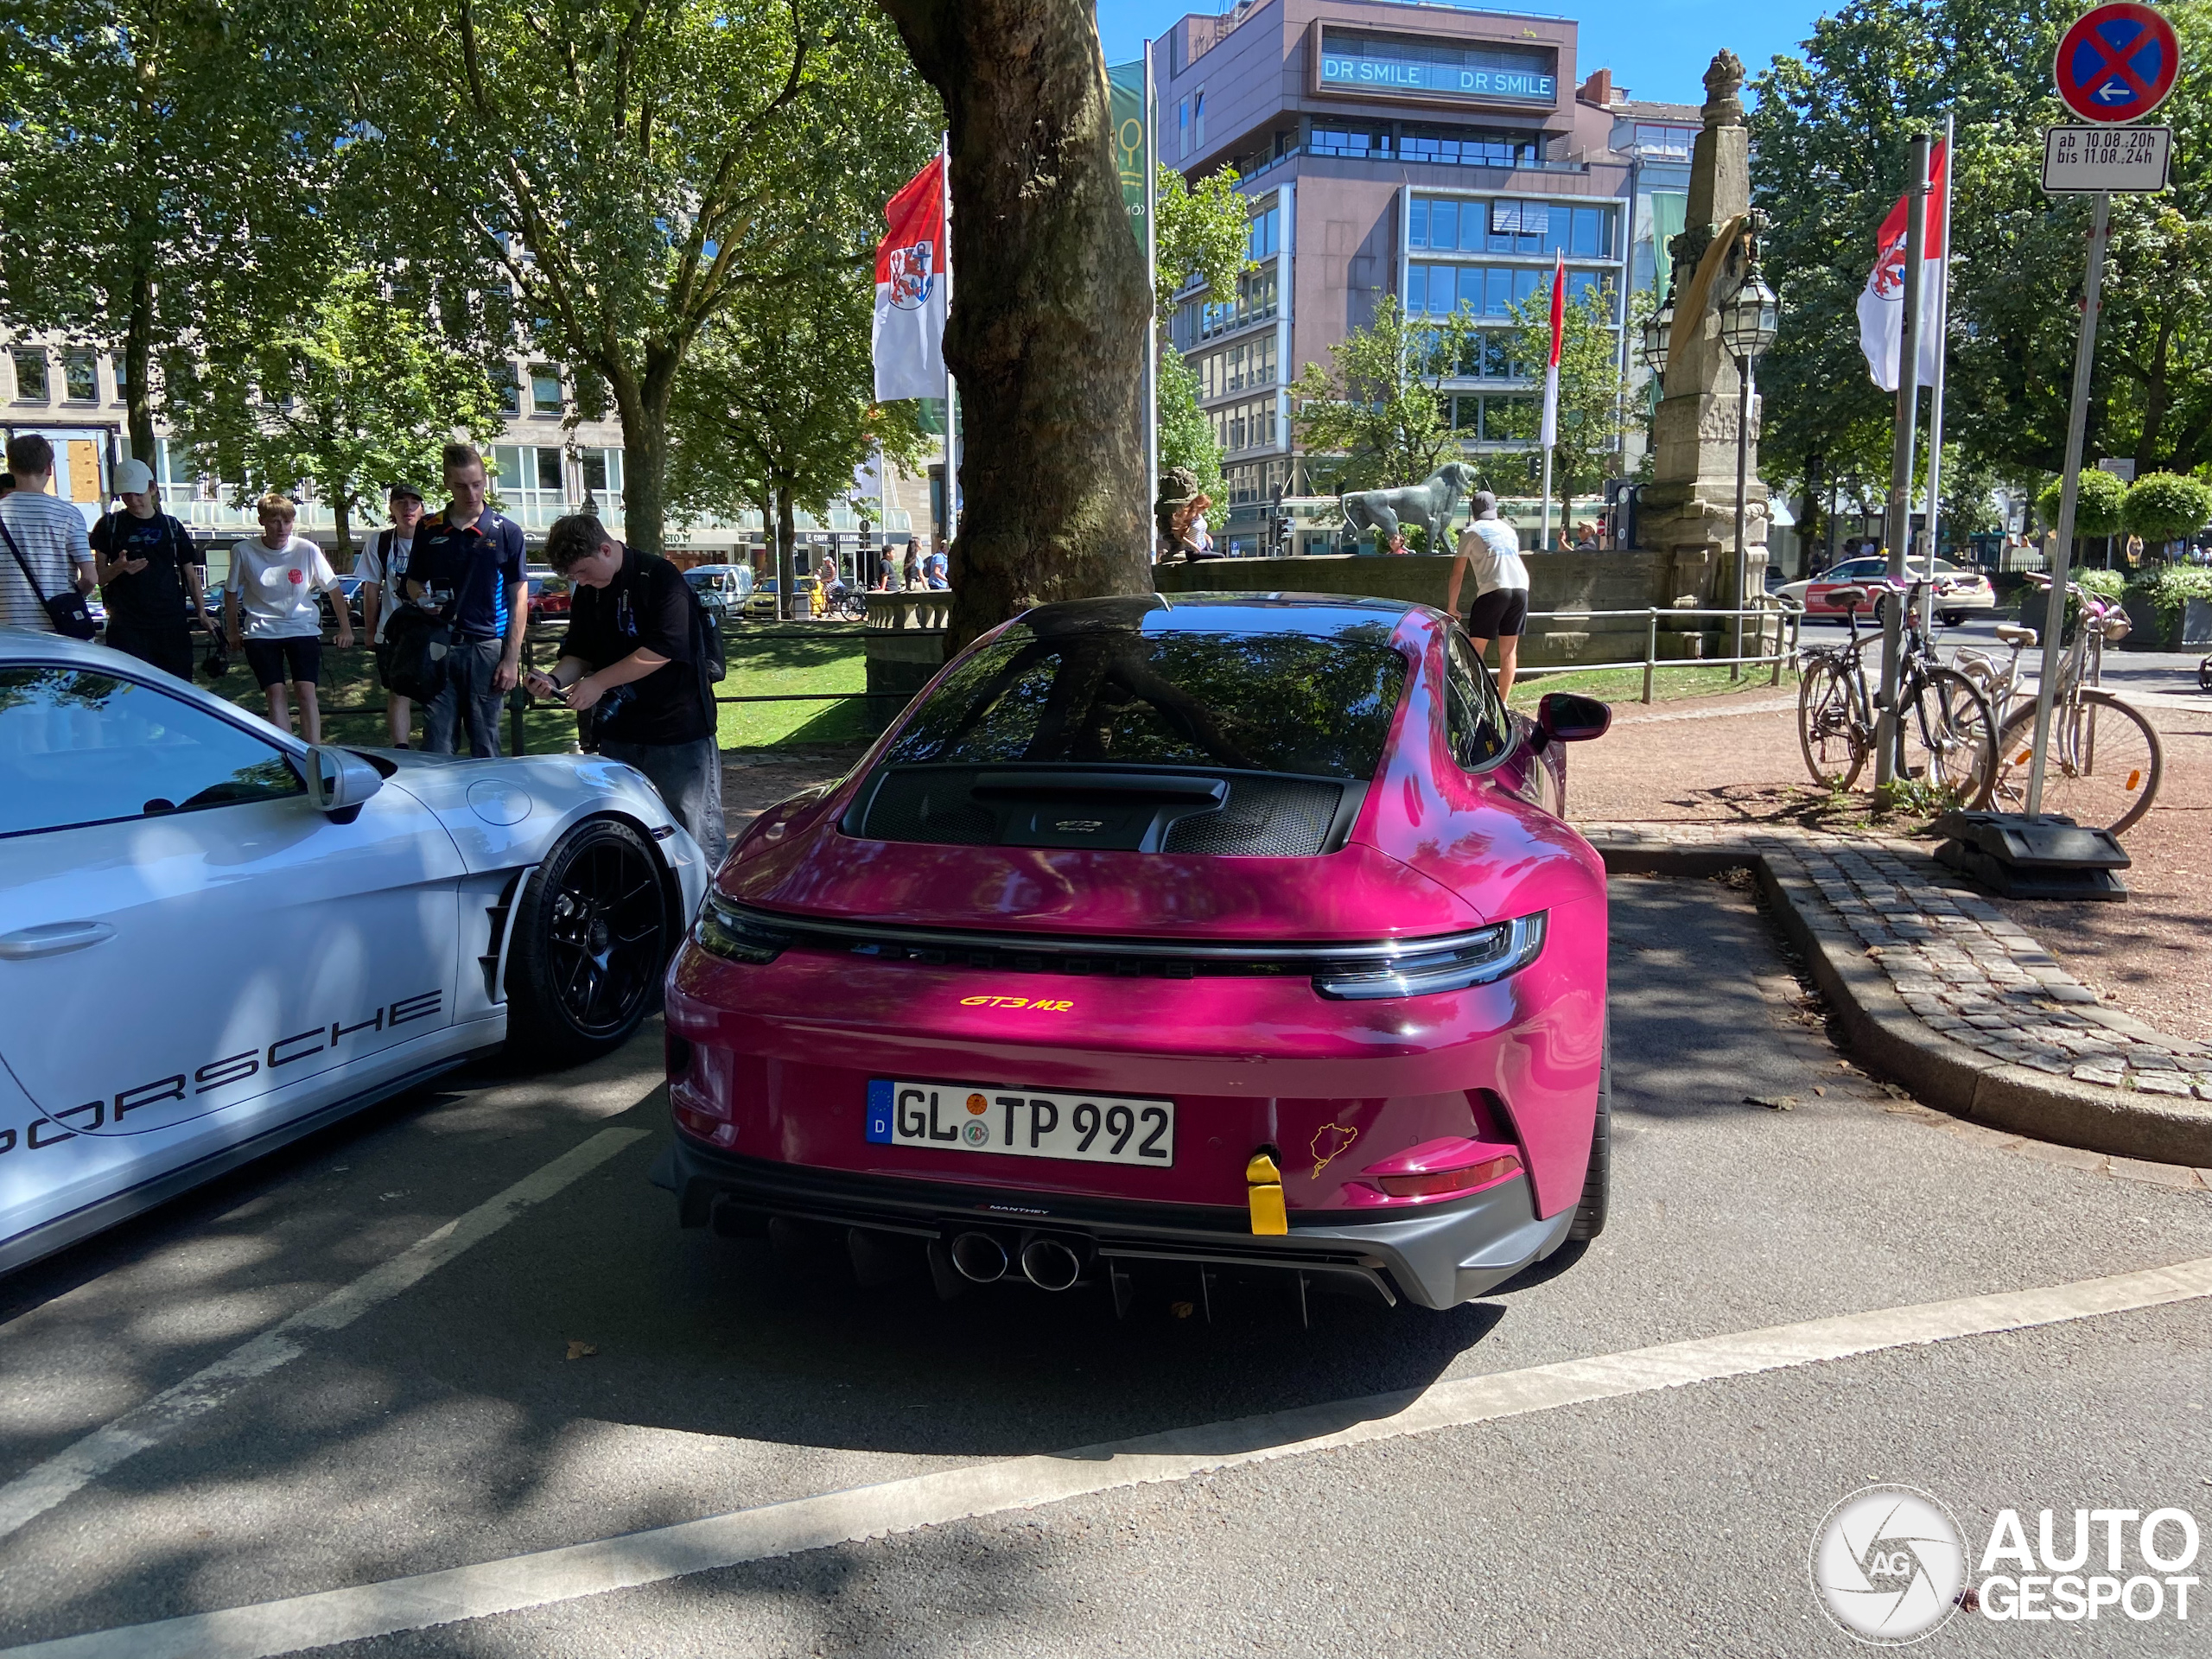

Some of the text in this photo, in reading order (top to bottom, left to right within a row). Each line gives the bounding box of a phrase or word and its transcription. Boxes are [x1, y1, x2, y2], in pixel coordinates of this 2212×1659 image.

[1325, 60, 1420, 84] DR SMILE
[1461, 71, 1551, 95] DR SMILE
[2059, 132, 2075, 148] ab
[2057, 149, 2077, 163] bis
[664, 534, 680, 543] STO
[839, 534, 863, 543] ELLOW
[960, 995, 1075, 1013] GT3 MR
[0, 989, 442, 1154] ORSCHE
[874, 1119, 886, 1135] D
[897, 1089, 1168, 1160] GL TP 992
[989, 1205, 1051, 1215] MANTHEY
